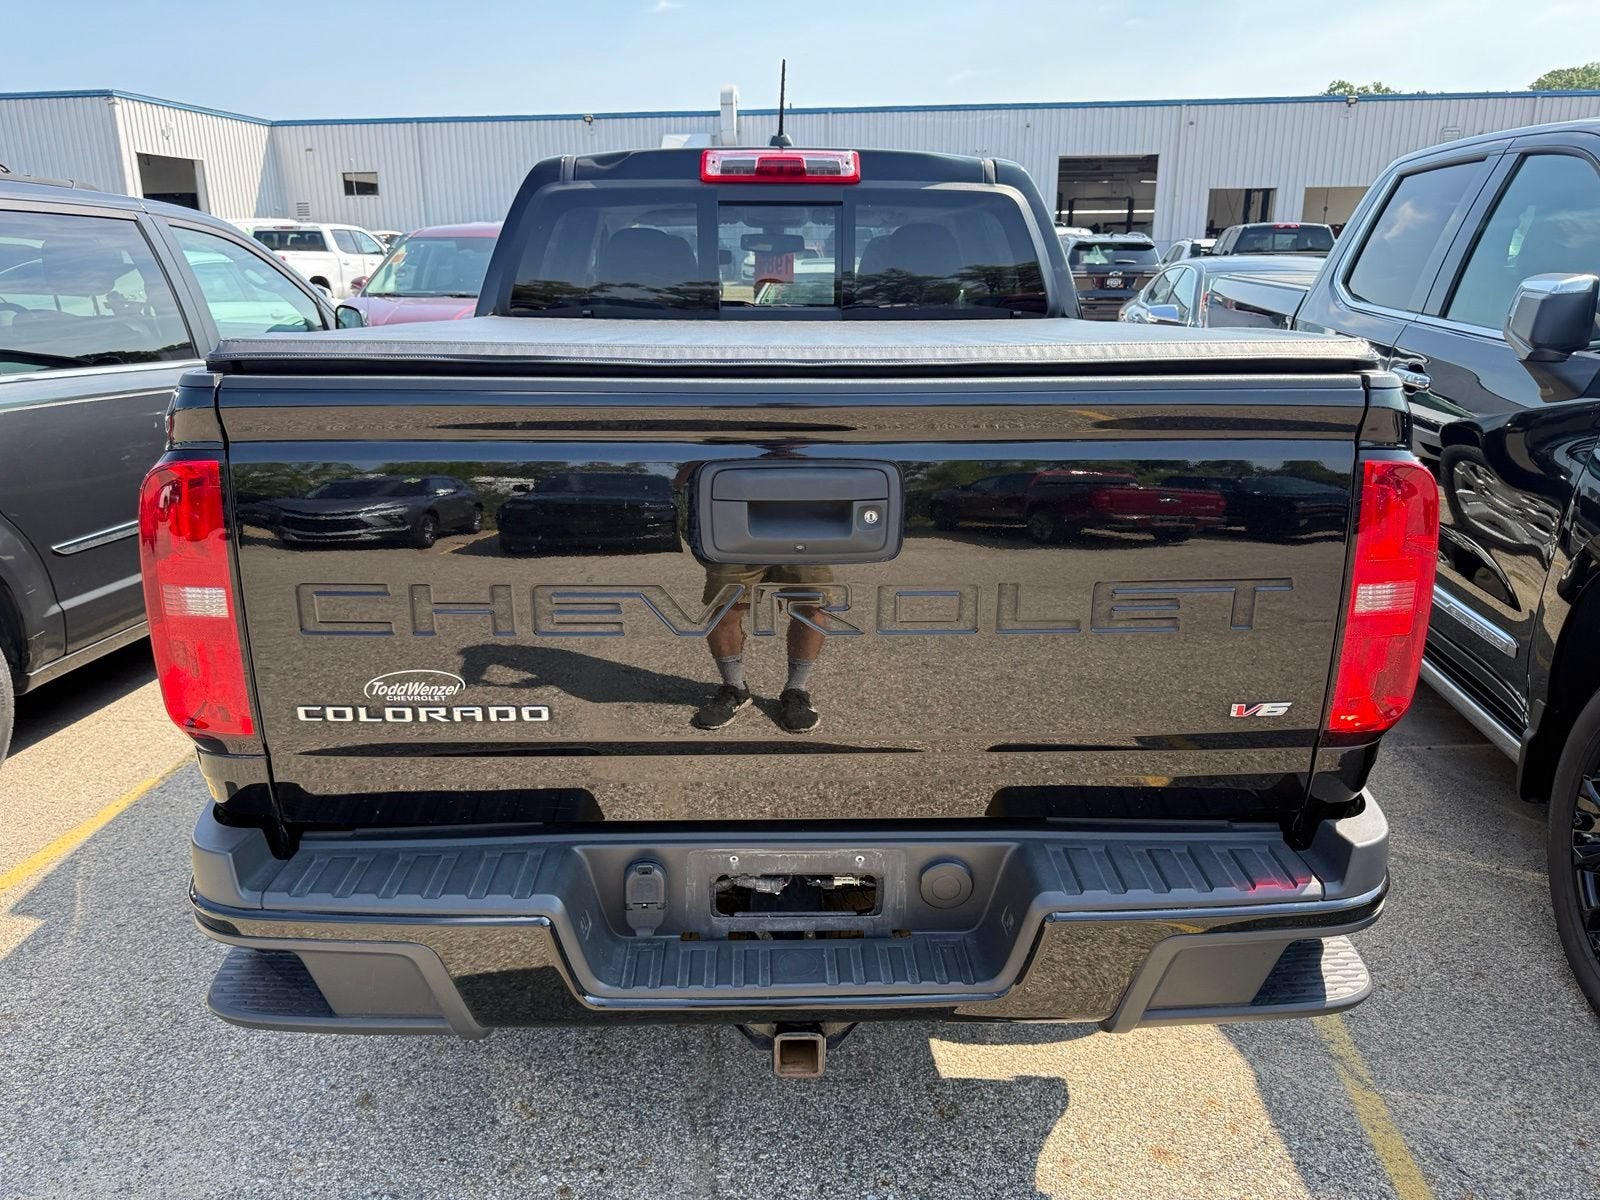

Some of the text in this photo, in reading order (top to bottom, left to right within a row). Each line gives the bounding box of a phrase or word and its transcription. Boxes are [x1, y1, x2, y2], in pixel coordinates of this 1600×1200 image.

[296, 577, 1293, 637] CHEVROLET
[297, 705, 550, 722] COLORADO
[1230, 702, 1293, 717] V6
